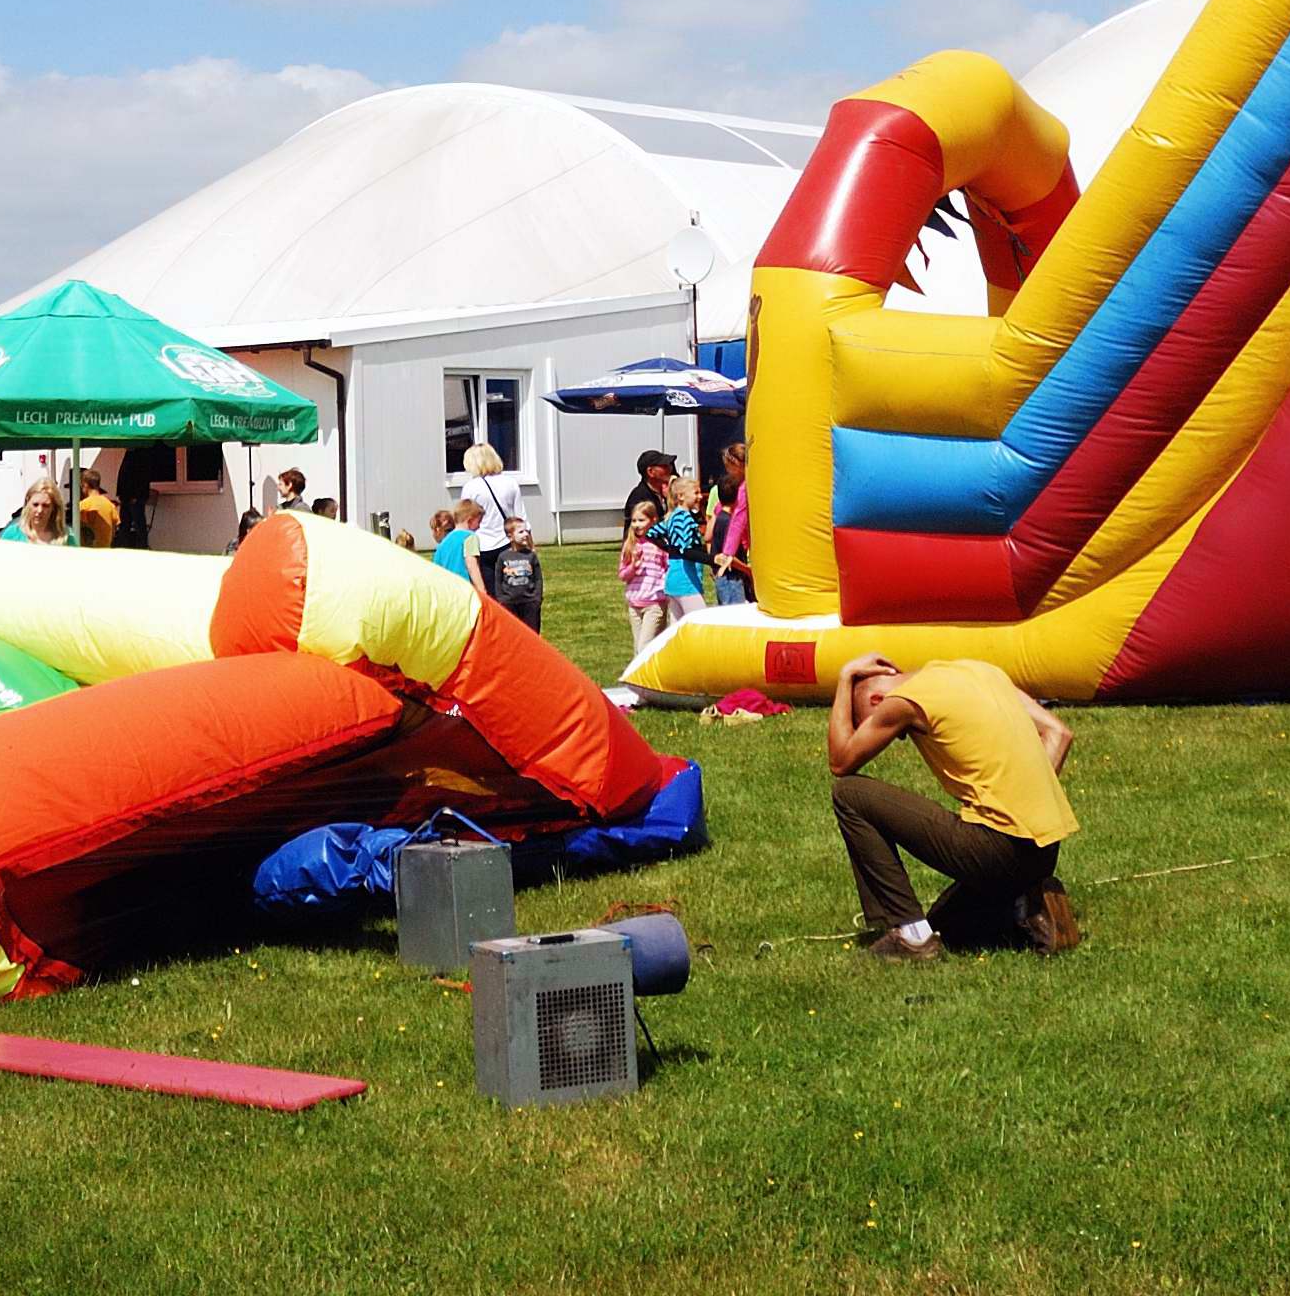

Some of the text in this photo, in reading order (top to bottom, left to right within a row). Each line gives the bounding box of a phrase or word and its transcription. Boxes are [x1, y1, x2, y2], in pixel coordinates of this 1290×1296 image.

[16, 411, 156, 427] LECH PREMIUM PUB
[210, 415, 296, 431] LECH PREMIUM PUB
